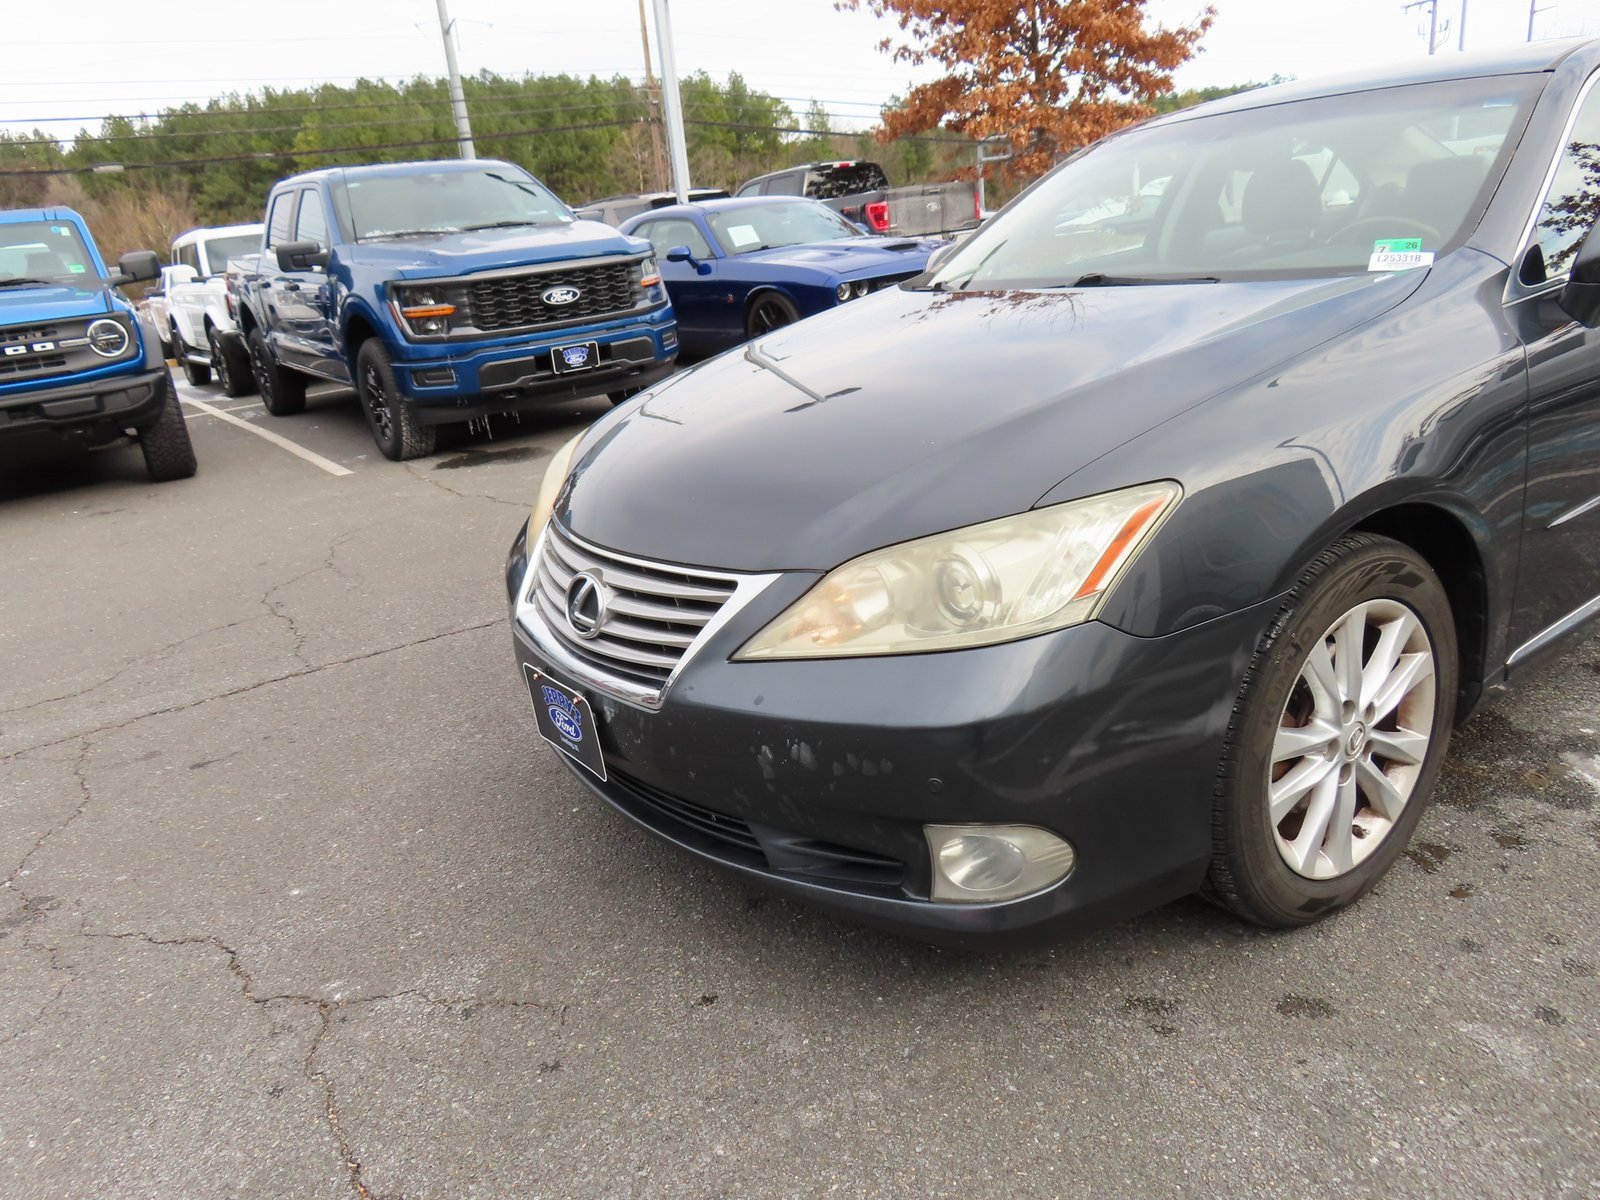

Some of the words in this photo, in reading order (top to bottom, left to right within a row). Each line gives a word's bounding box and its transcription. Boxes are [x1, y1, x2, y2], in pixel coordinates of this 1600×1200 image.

[1405, 241, 1418, 249] 26
[551, 289, 573, 302] Ford
[555, 710, 577, 737] Ford
